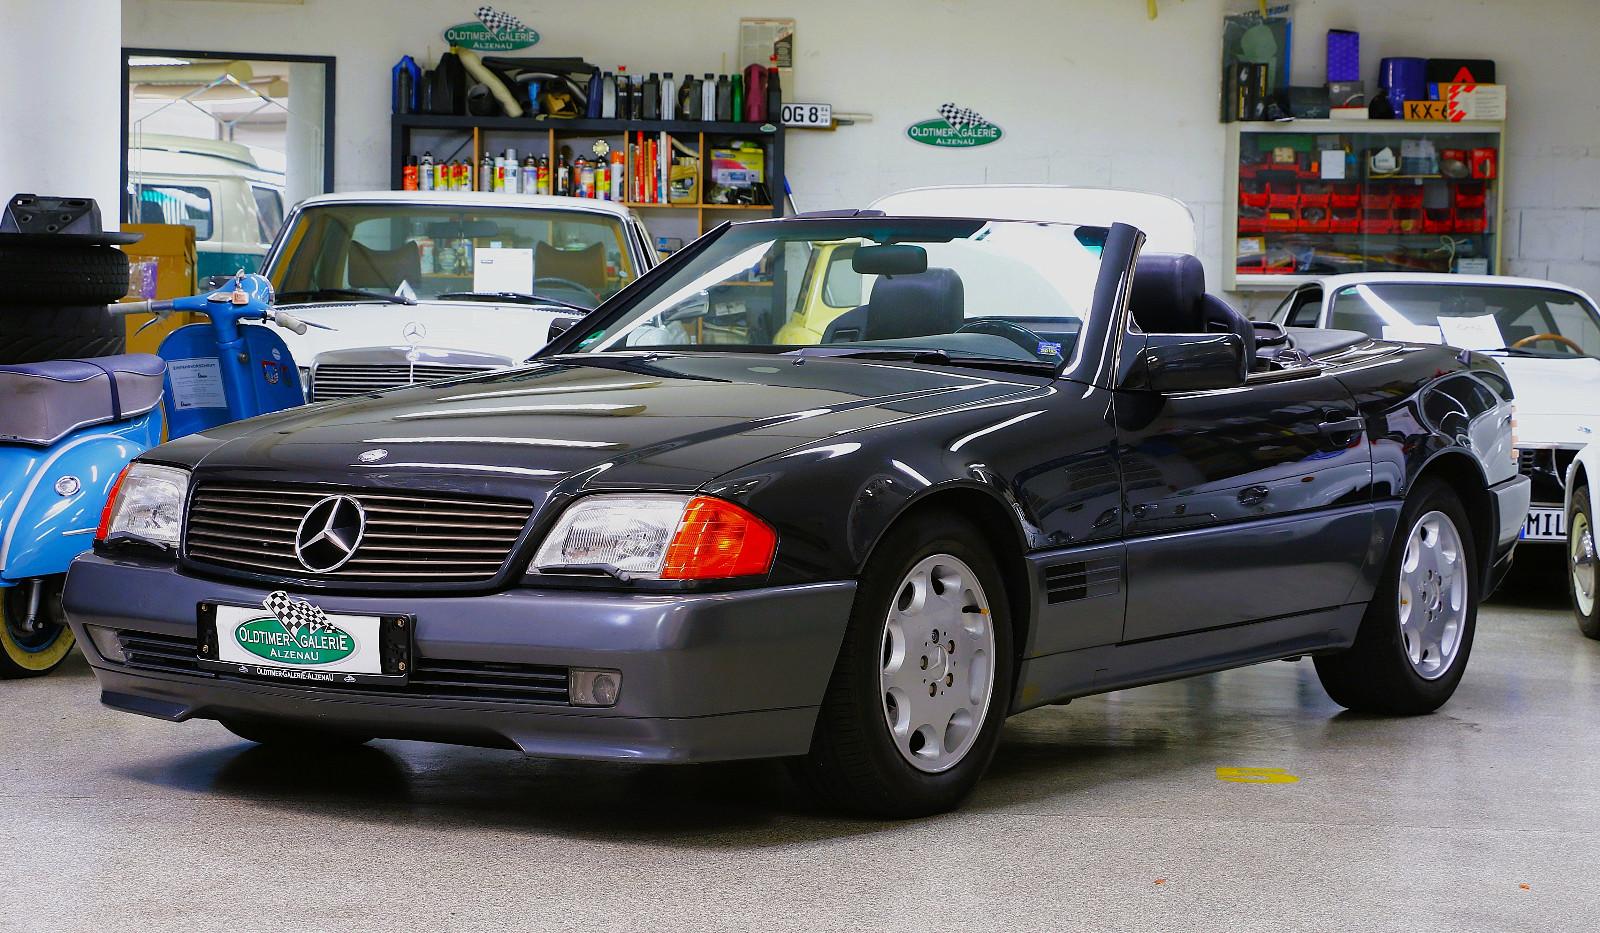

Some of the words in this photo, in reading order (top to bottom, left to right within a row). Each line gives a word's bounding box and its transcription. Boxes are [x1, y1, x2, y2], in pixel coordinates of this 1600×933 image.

[498, 31, 535, 42] GALERIE
[472, 42, 513, 50] ALZENAU
[782, 105, 804, 123] OG
[808, 106, 819, 123] 8
[961, 127, 998, 138] GALERIE
[936, 137, 975, 145] ALZENAU
[1526, 513, 1567, 537] MIL
[300, 634, 349, 651] GALERIE
[270, 647, 319, 661] ALZENAU
